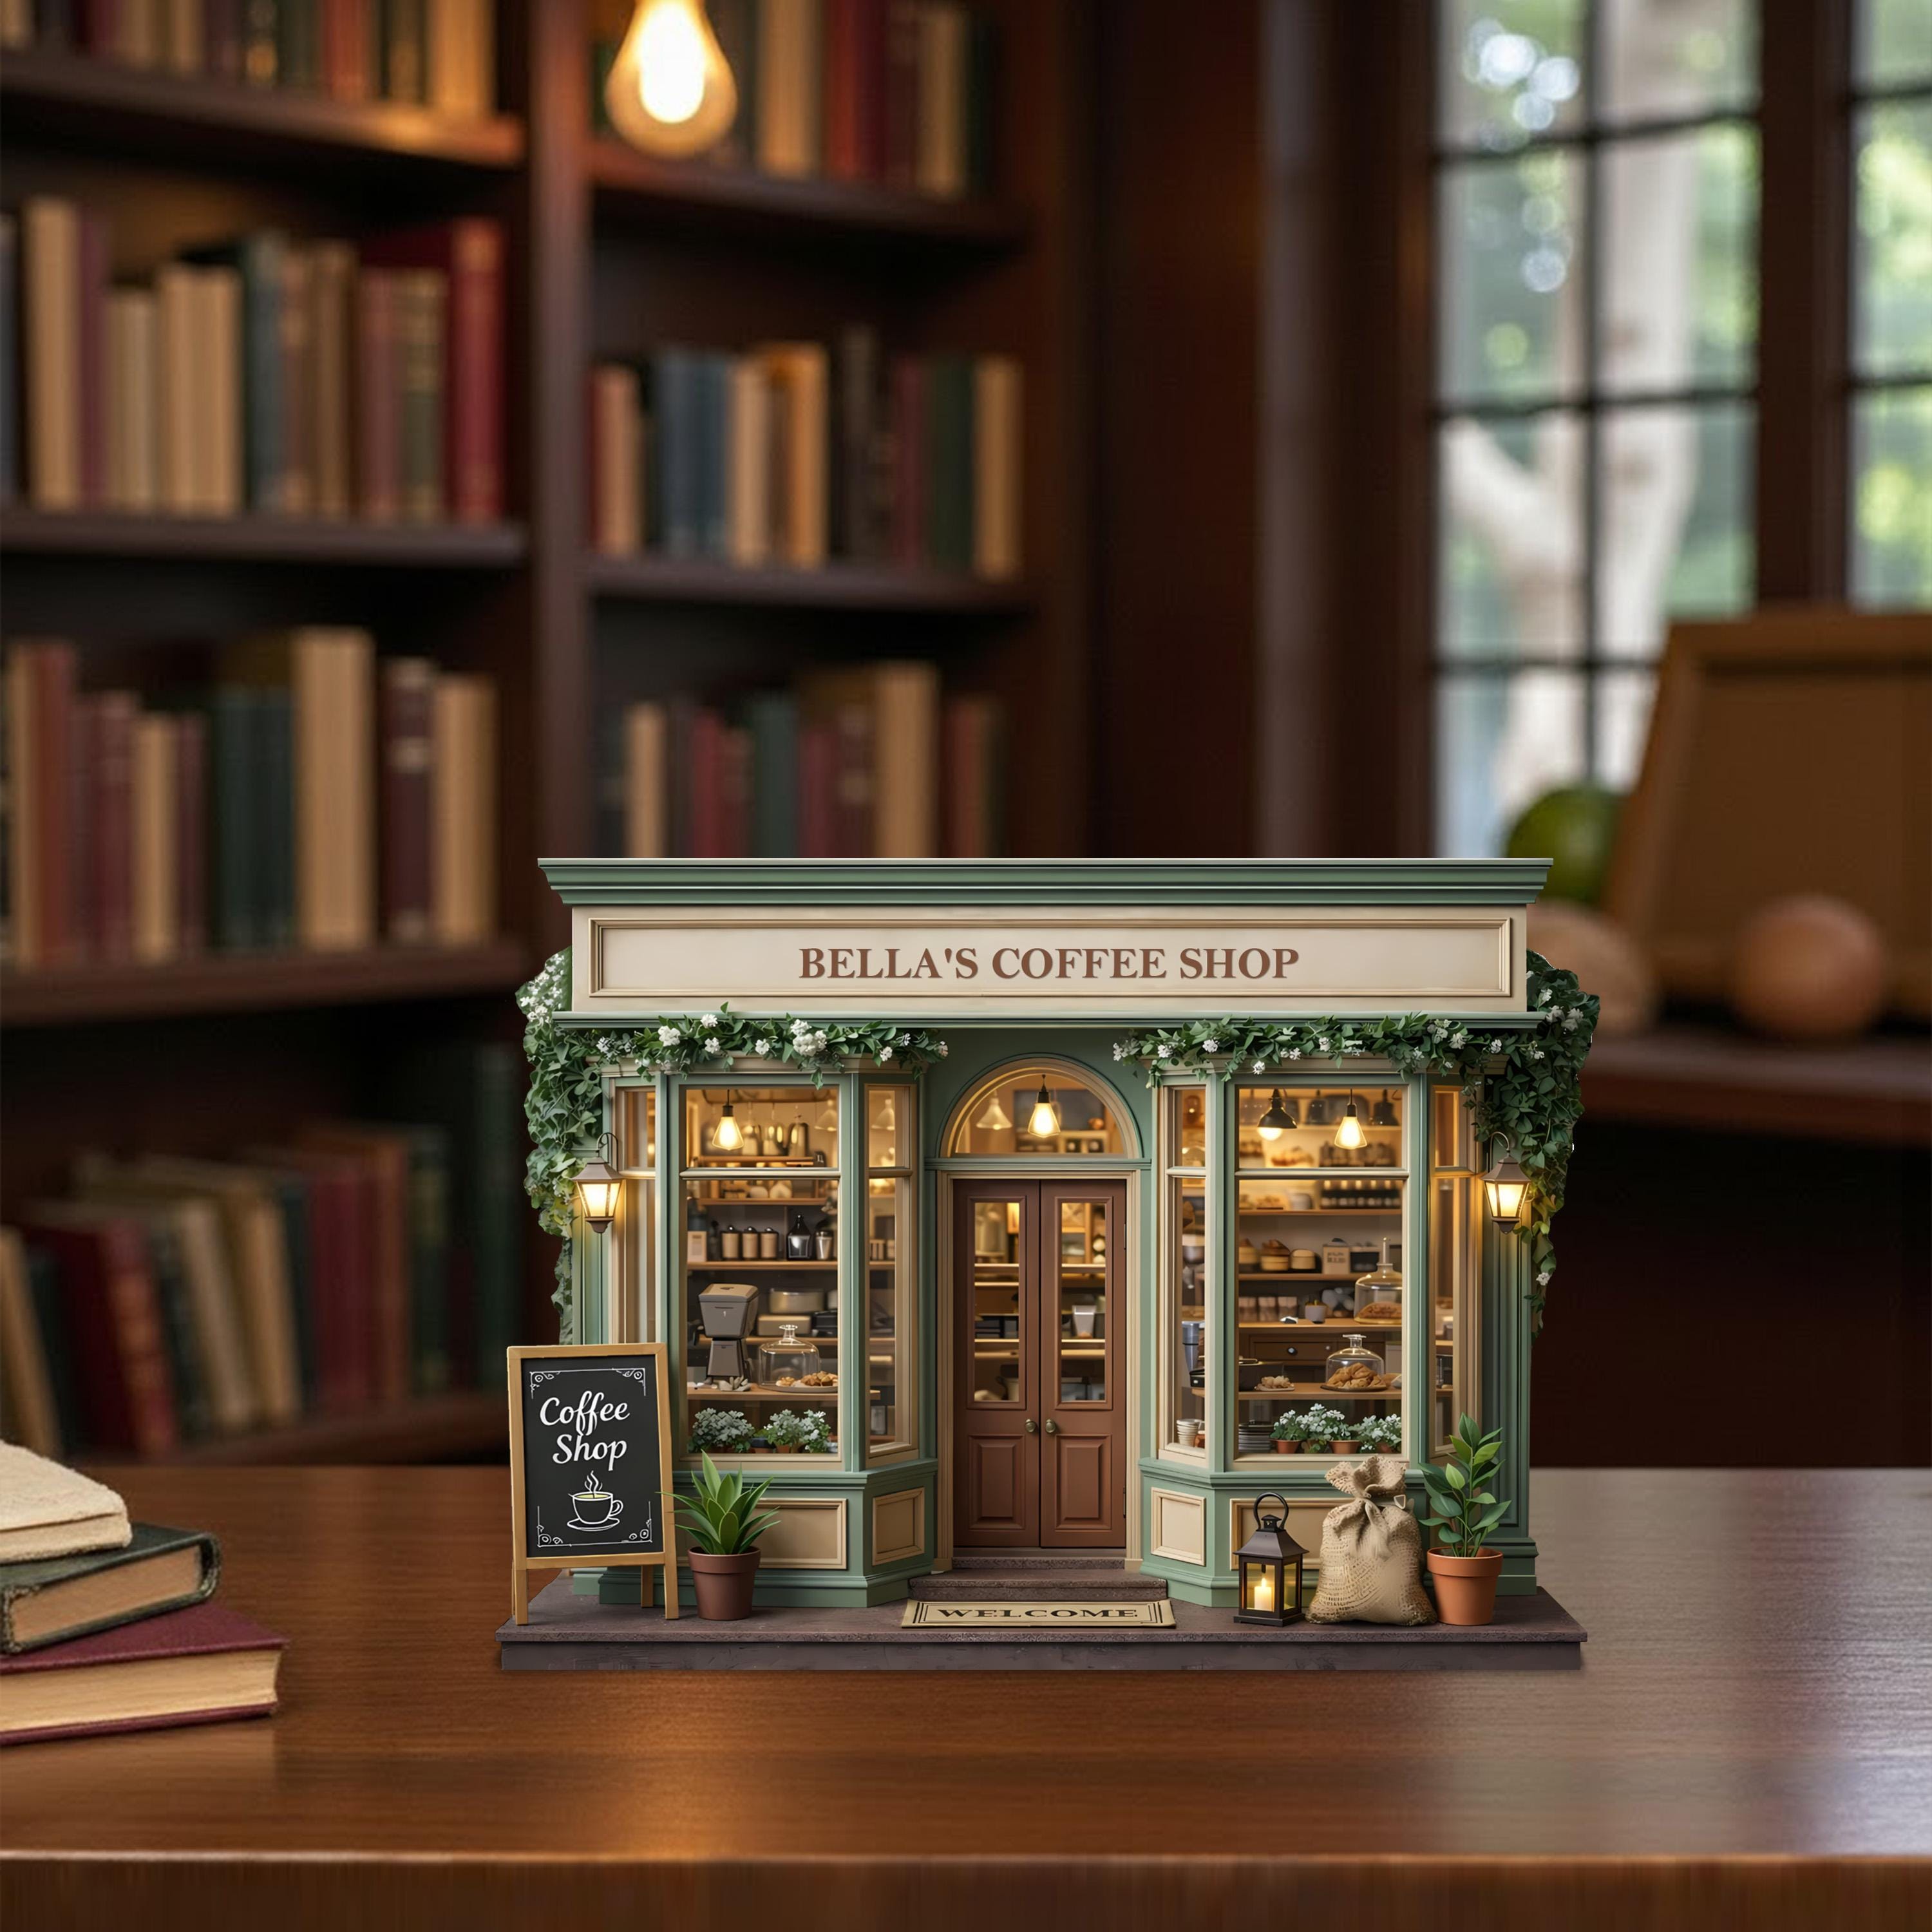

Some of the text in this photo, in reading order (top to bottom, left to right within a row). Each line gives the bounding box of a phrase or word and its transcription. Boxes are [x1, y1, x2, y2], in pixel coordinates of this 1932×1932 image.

[799, 947, 1300, 980] BELLA'S COFFEE SHOP
[540, 1390, 630, 1436] Coffee
[552, 1434, 627, 1472] Shop
[938, 1609, 1137, 1618] WELCOME
